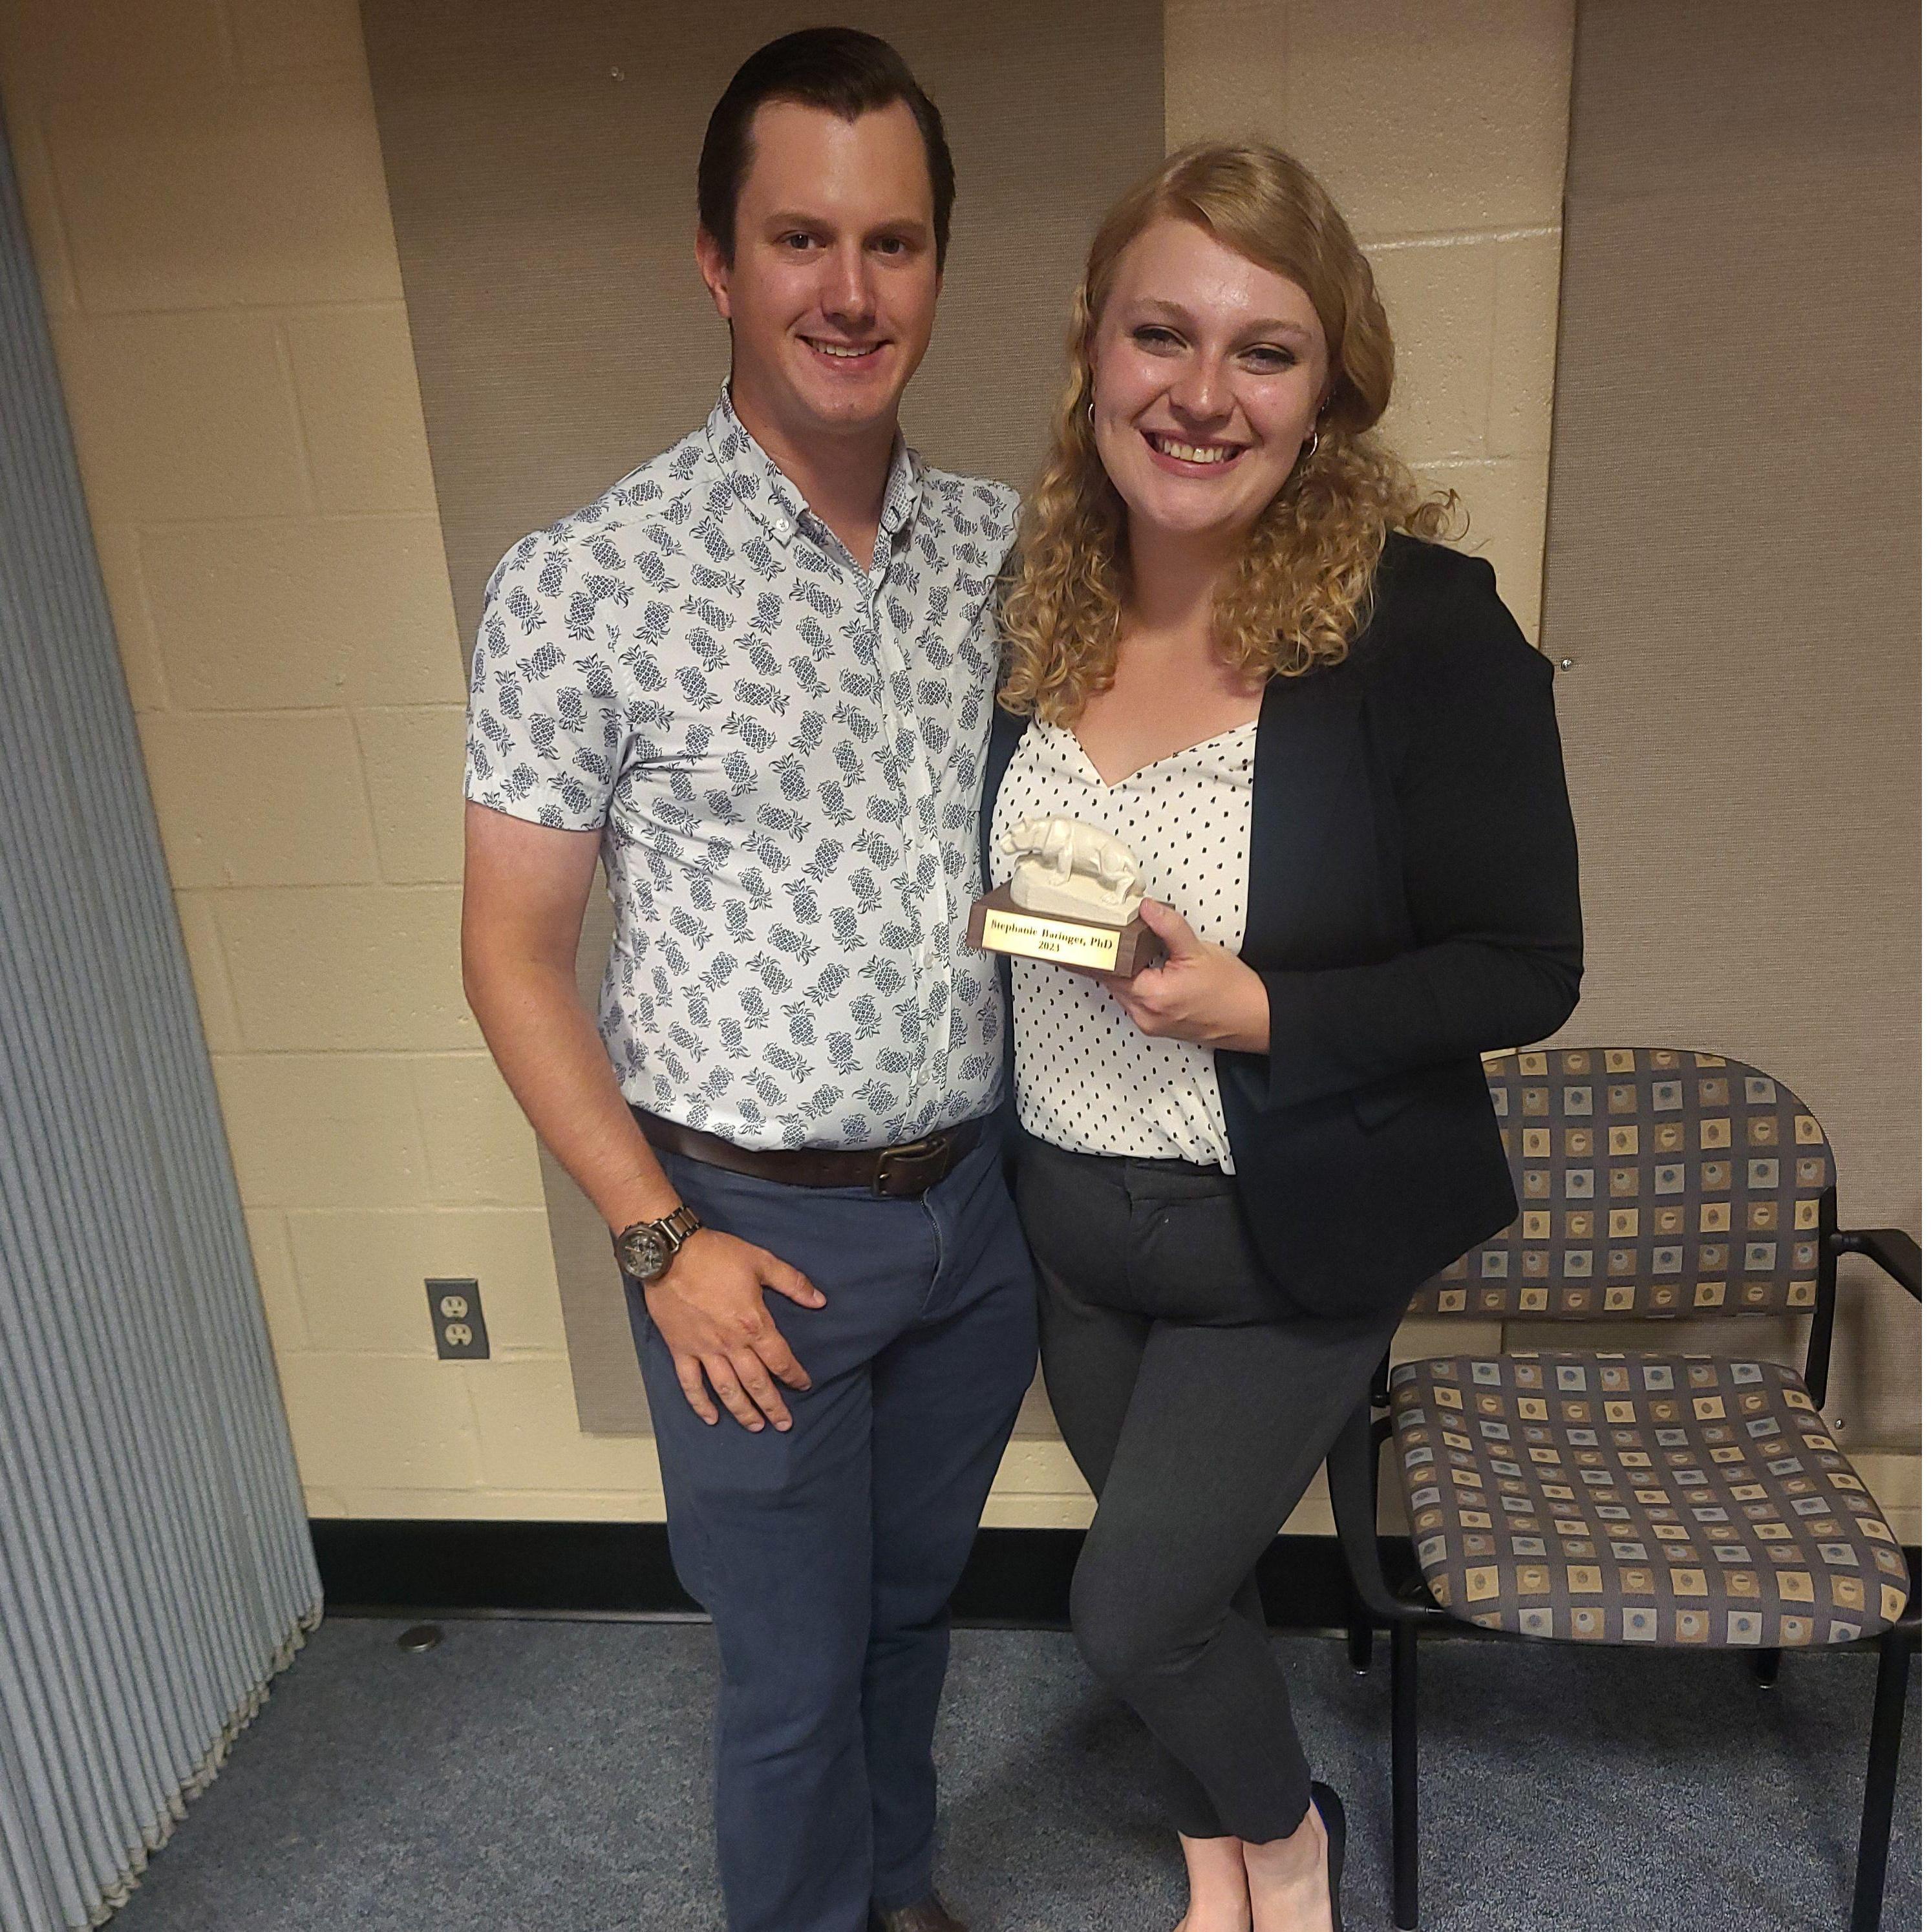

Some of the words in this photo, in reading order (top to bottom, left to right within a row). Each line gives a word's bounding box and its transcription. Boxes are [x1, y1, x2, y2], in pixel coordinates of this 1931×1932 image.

[991, 919, 1038, 936] Stephanie
[1042, 929, 1086, 946] Baringer,
[1091, 937, 1113, 950] PhD
